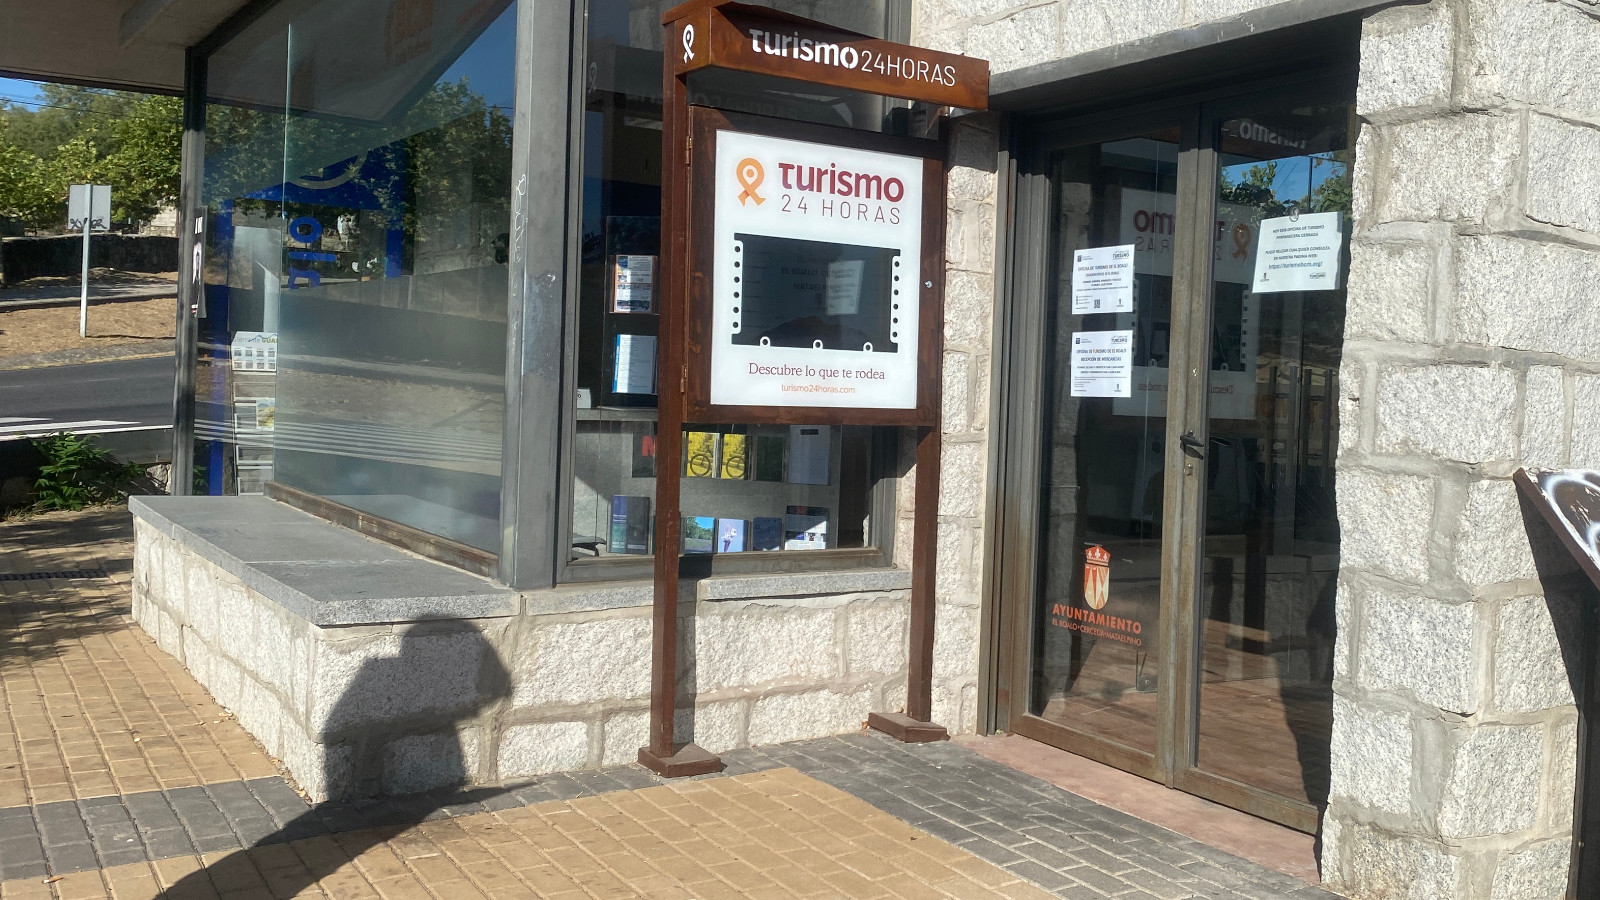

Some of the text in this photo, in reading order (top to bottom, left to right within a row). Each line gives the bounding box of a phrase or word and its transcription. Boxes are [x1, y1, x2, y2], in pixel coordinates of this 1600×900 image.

[781, 194, 901, 225] 24 HORAS
[749, 363, 885, 380] Descubre lo que te rodea
[781, 384, 856, 394] turismo24horas.com
[1052, 603, 1142, 635] AYUNTAMIENTO
